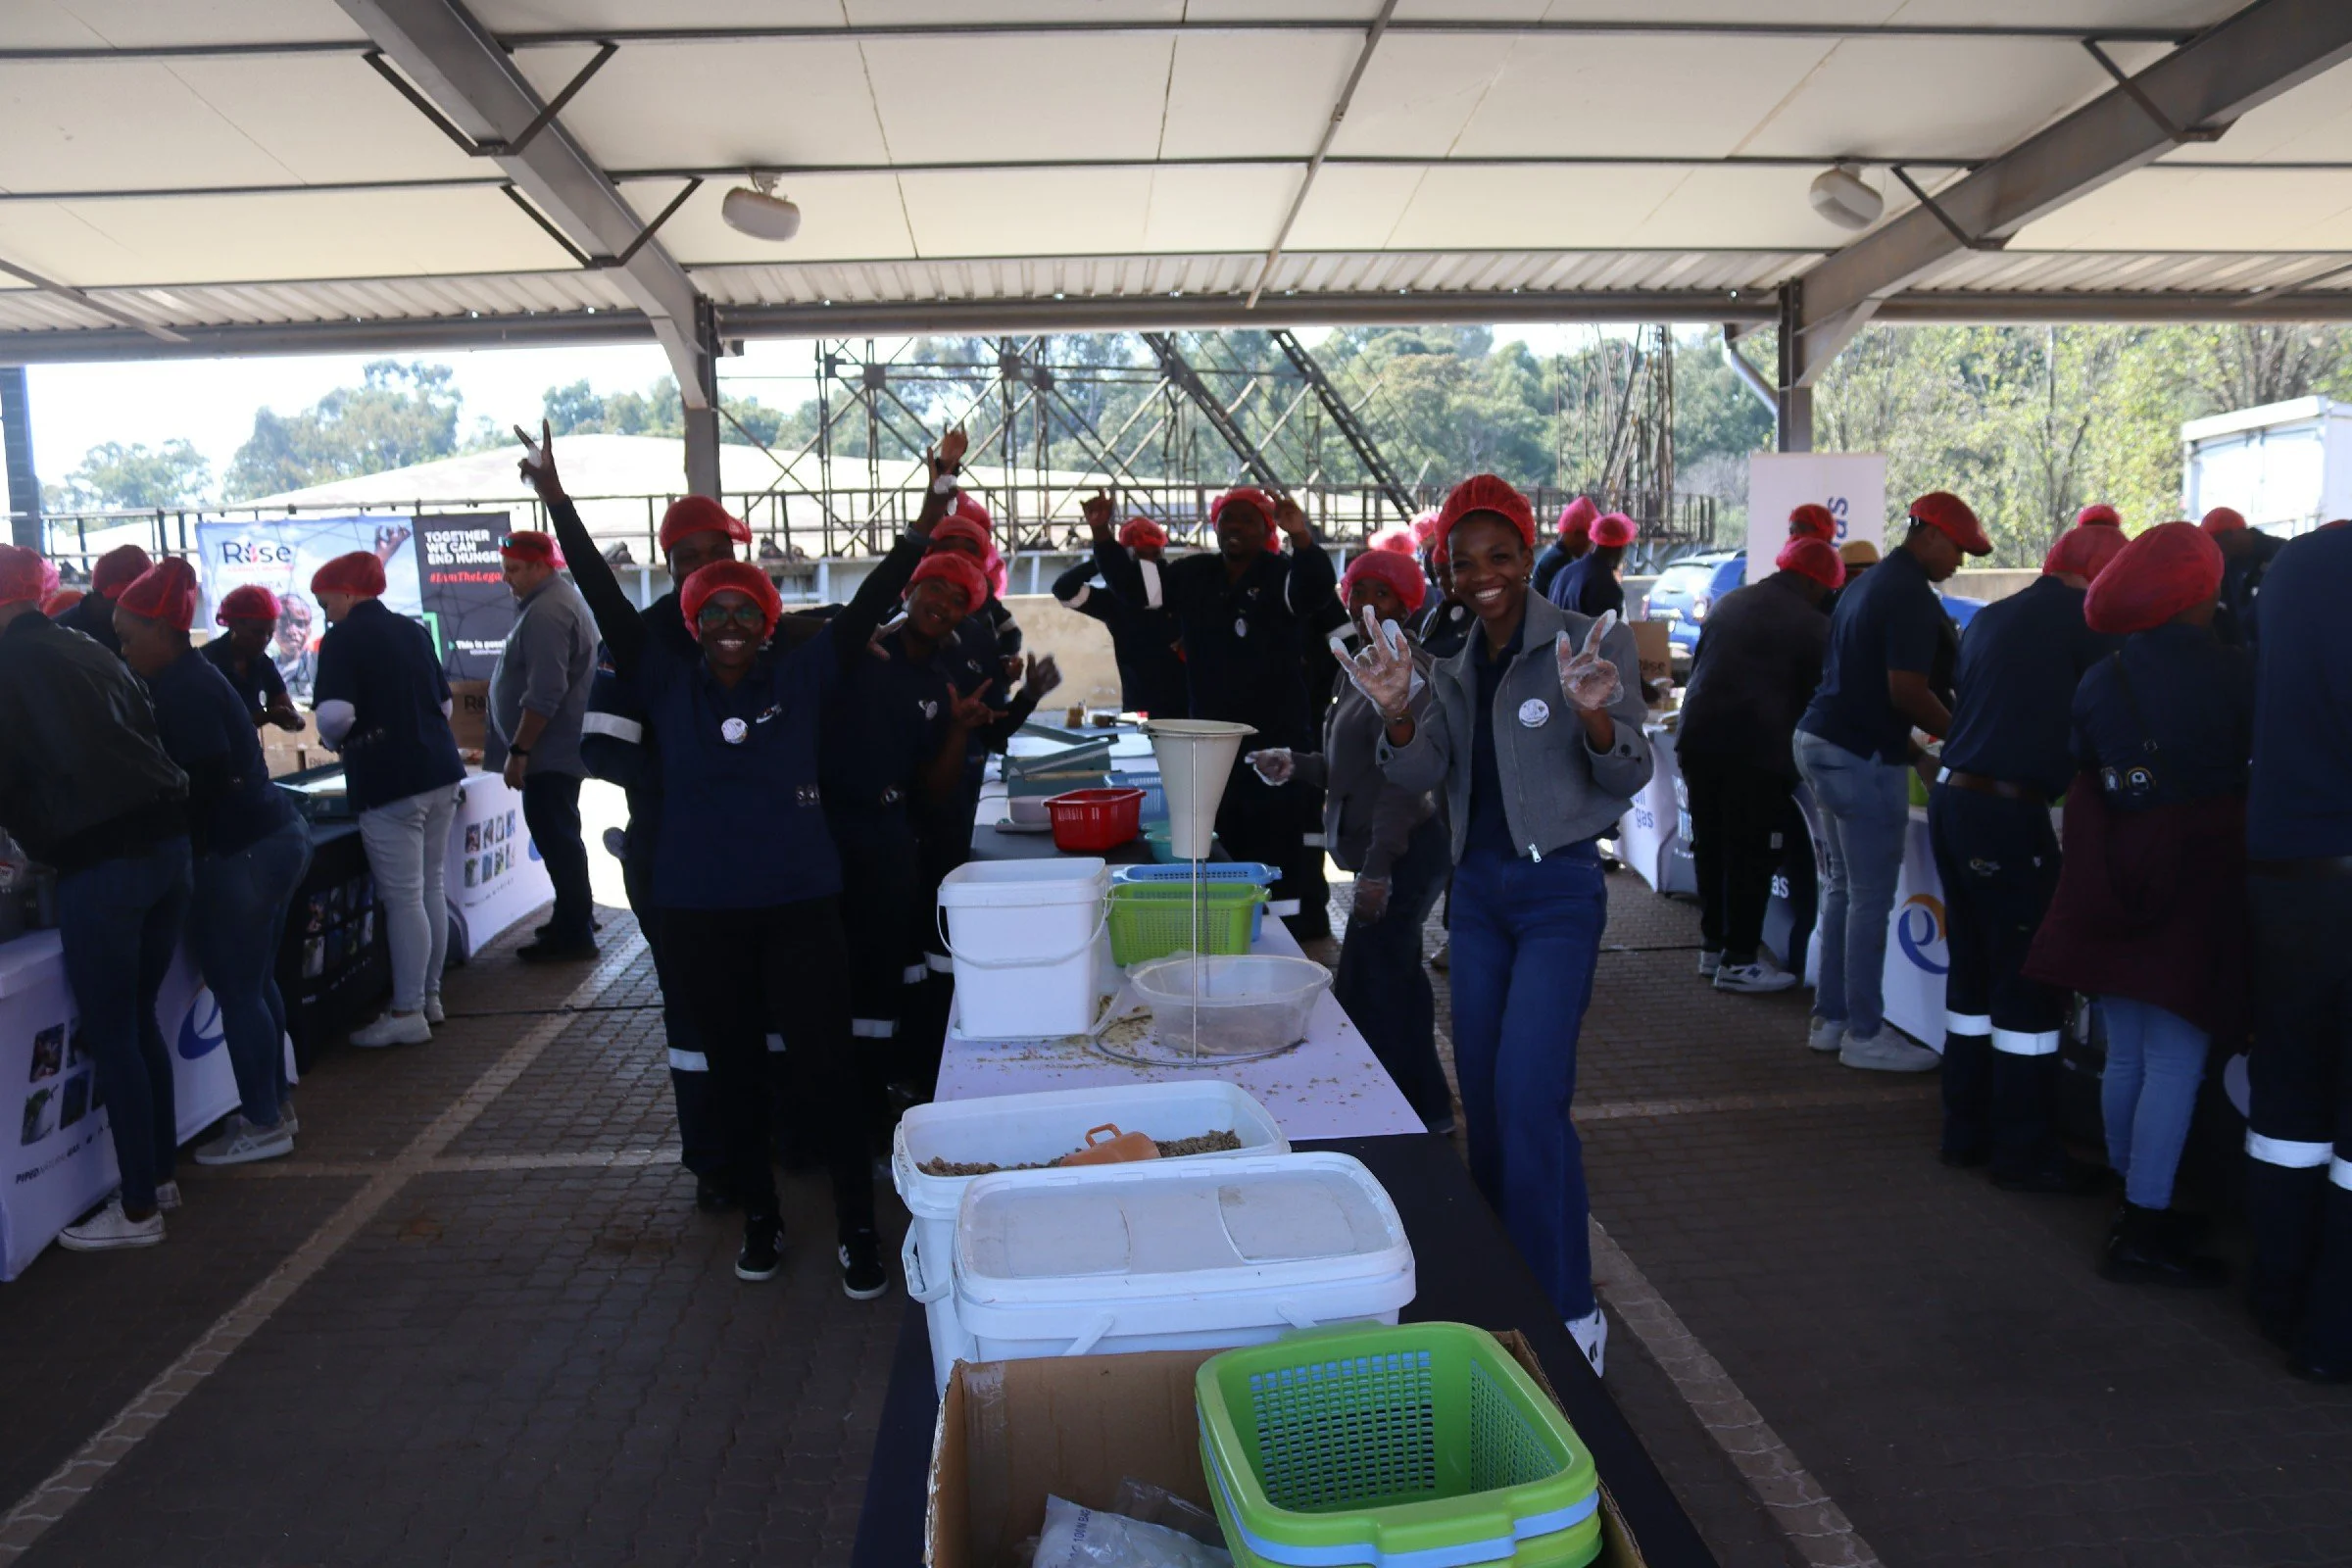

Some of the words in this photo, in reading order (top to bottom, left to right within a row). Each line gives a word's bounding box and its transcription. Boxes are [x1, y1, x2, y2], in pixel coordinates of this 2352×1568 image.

[424, 529, 490, 544] TOGETHER
[222, 541, 292, 564] Rise
[426, 542, 448, 555] WE
[450, 541, 477, 554] CAN
[427, 553, 454, 565] END
[1636, 808, 1655, 829] gas
